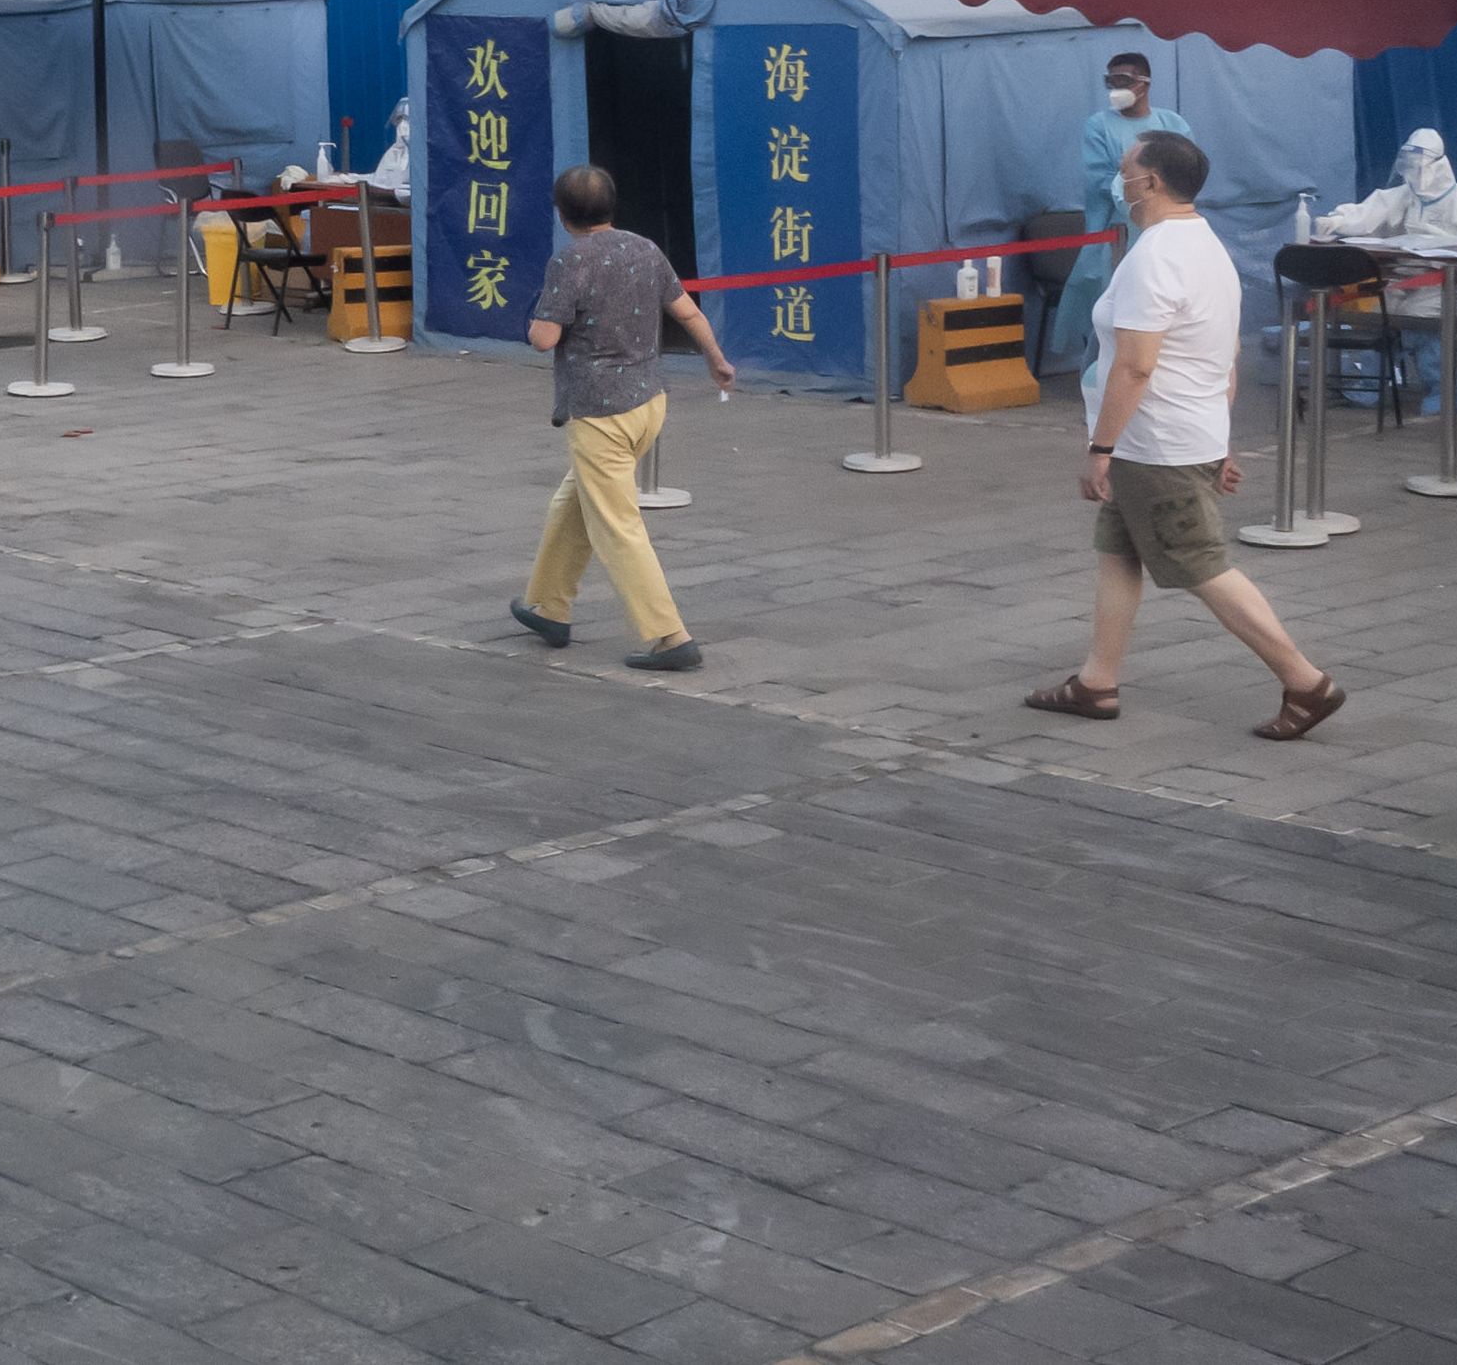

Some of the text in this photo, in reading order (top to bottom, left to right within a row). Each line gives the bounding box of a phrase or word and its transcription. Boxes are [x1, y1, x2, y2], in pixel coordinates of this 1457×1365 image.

[464, 38, 512, 311] 欢迎回家
[764, 43, 817, 342] 海淀街道
